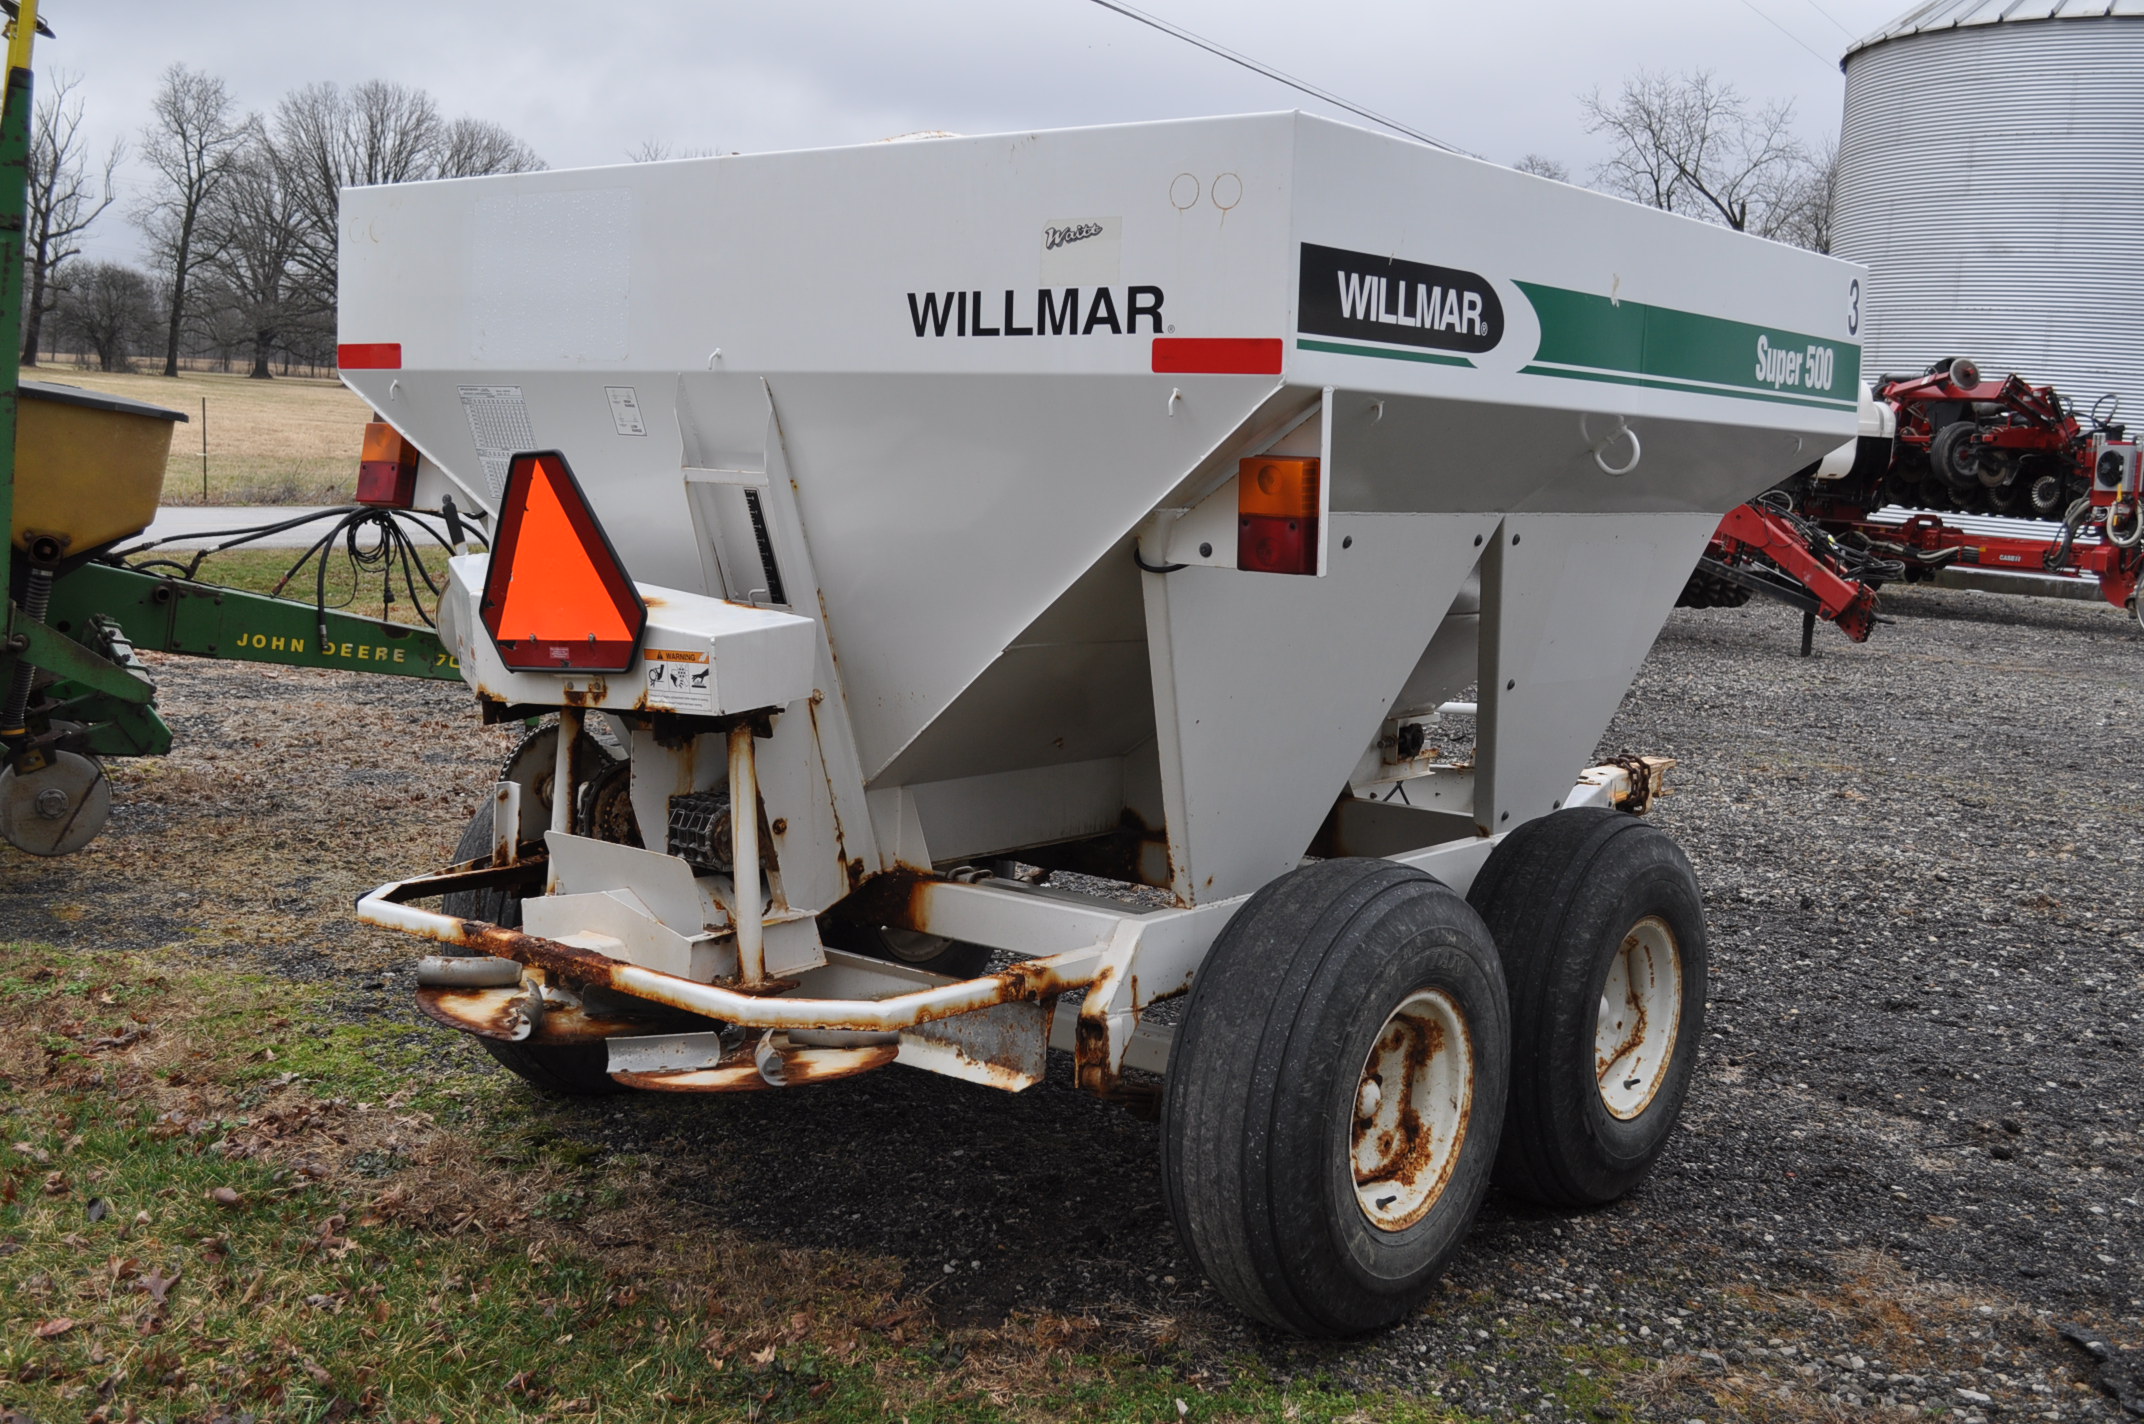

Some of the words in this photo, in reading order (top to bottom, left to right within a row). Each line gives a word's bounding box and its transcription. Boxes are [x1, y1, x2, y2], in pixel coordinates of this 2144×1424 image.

[1848, 279, 1859, 336] 3
[1755, 334, 1804, 390] Super
[1805, 345, 1834, 391] 500
[236, 633, 304, 653] JOHN
[321, 642, 406, 663] DEERE
[666, 652, 696, 662] WARNING
